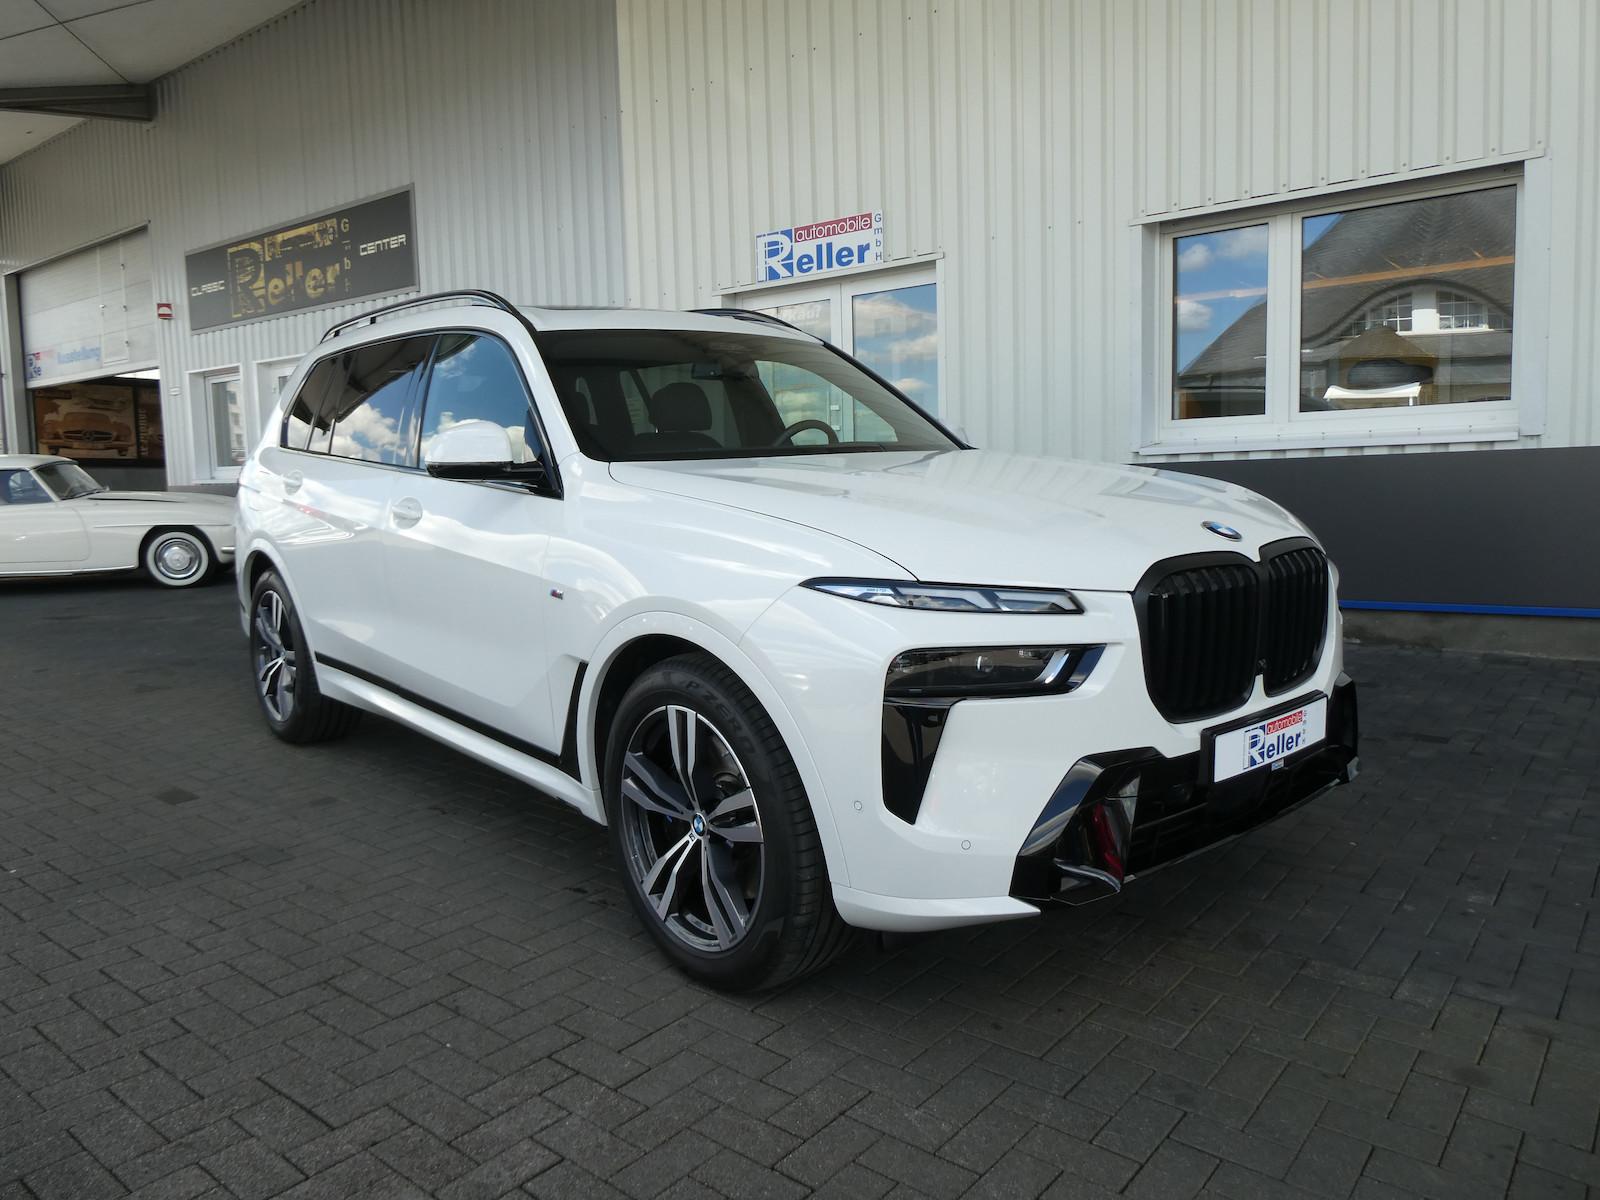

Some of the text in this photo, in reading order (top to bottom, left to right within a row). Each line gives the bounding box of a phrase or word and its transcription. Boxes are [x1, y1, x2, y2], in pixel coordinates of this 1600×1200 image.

[359, 234, 407, 257] CENTER
[796, 216, 871, 242] automobile
[874, 213, 883, 262] GmbH
[756, 229, 871, 282] Reller
[1267, 711, 1303, 734] automobile
[1243, 724, 1301, 770] Reller
